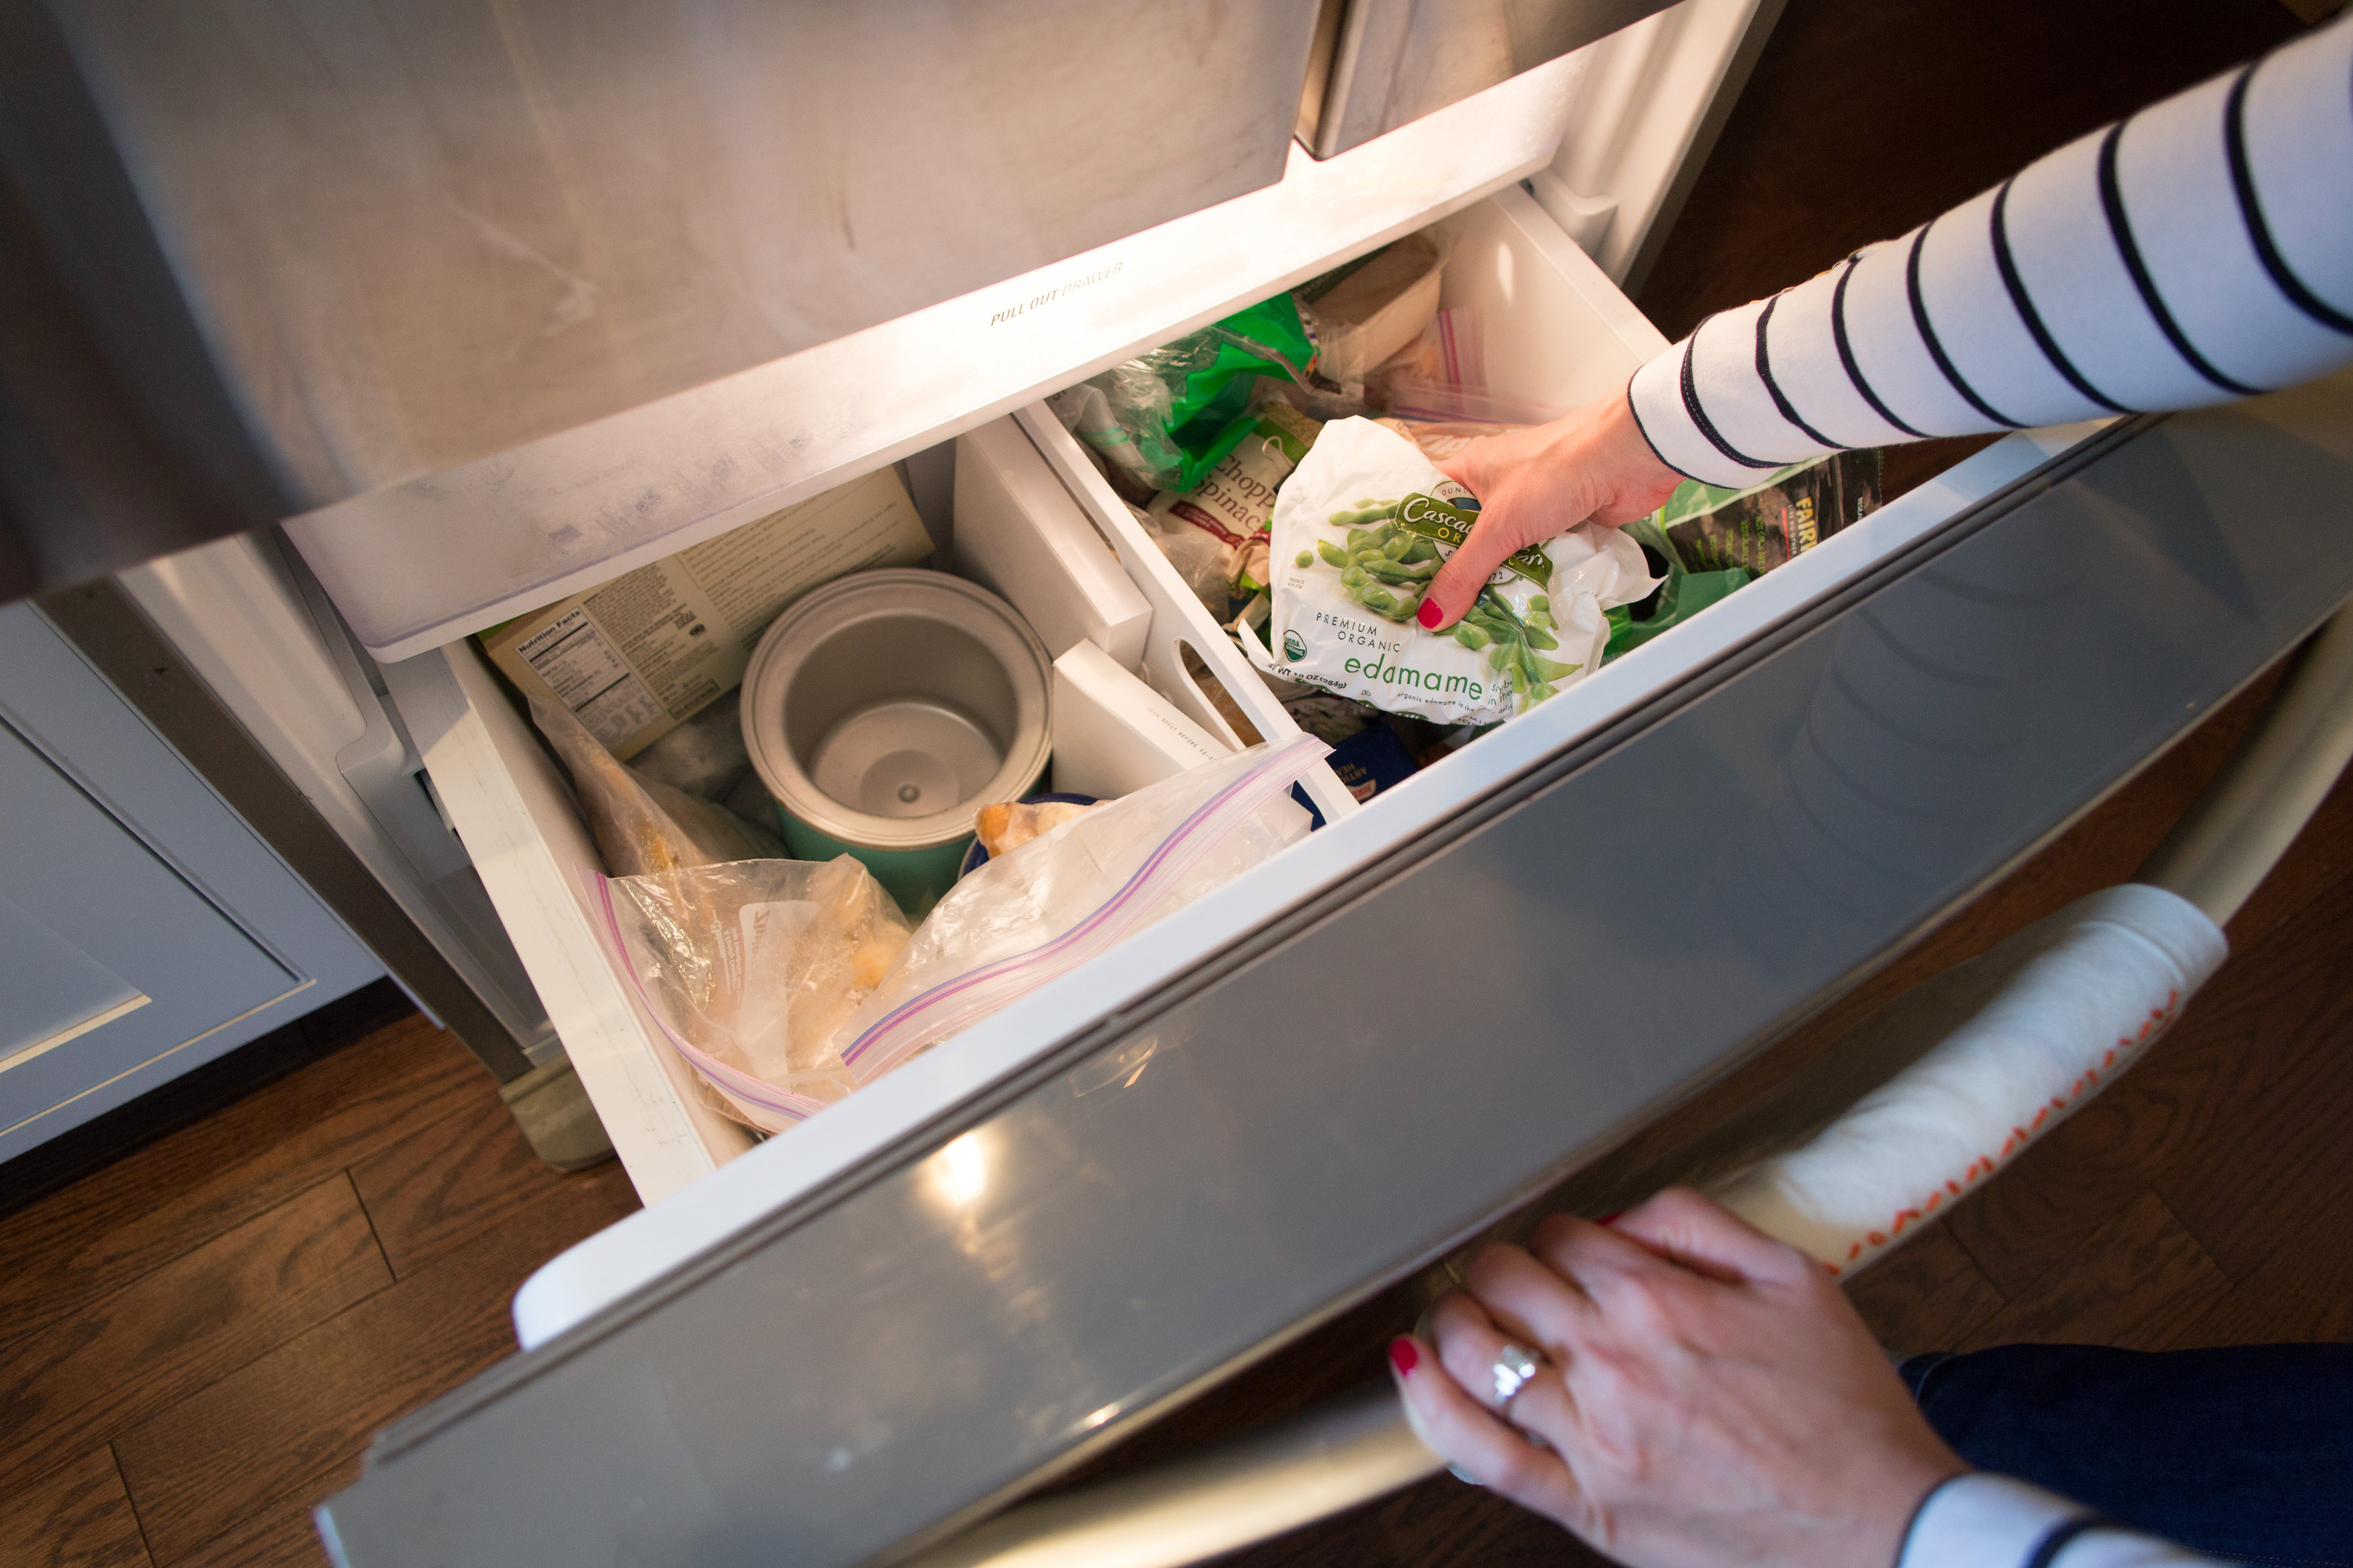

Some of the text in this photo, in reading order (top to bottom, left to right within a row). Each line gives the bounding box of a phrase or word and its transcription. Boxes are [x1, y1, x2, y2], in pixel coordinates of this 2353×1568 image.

[991, 262, 1123, 326] PULL OUT DRAWER
[1316, 612, 1377, 636] PREMIUM
[1285, 637, 1300, 648] USDA
[1338, 630, 1401, 653] ORGANIC
[1345, 653, 1482, 700] edamame
[1397, 692, 1423, 703] organic
[1458, 700, 1464, 708] in
[1488, 690, 1512, 706] in the
